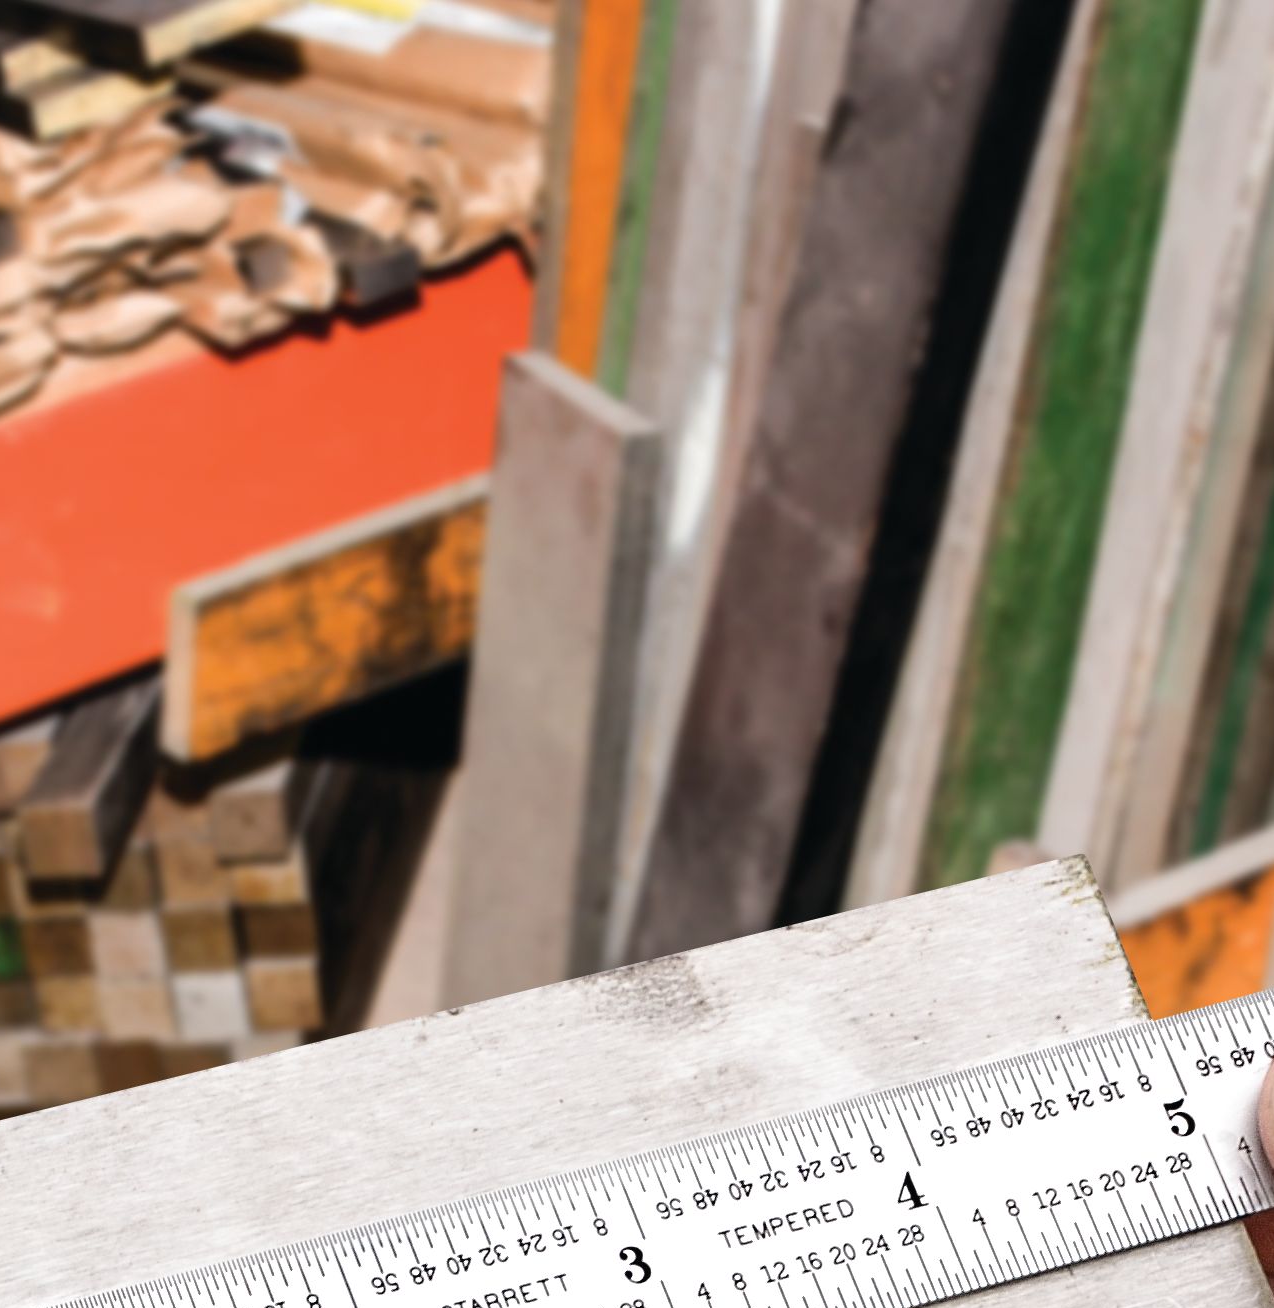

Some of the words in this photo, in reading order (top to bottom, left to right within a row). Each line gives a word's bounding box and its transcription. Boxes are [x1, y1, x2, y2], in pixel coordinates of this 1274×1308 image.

[1196, 1056, 1222, 1076] 56
[1230, 1047, 1254, 1067] 48
[1099, 1082, 1125, 1102] 16
[1138, 1075, 1152, 1092] 8
[1030, 1099, 1059, 1120] 32
[1067, 1089, 1094, 1110] 24
[966, 1117, 991, 1137] 48
[1001, 1109, 1024, 1128] 40
[931, 1126, 957, 1146] 56
[831, 1152, 857, 1173] 16
[870, 1146, 884, 1162] 8
[760, 1171, 788, 1191] 32
[797, 1160, 825, 1182] 24
[620, 1247, 651, 1284] 3
[898, 1172, 928, 1210] 4
[1164, 1098, 1195, 1136] 5
[693, 1189, 718, 1209] 48
[729, 1180, 752, 1200] 40
[657, 1199, 683, 1219] 56
[698, 1283, 711, 1300] 4
[732, 1273, 746, 1290] 8
[760, 1262, 789, 1283] 12
[796, 1252, 822, 1273] 16
[830, 1243, 855, 1264] 20
[862, 1234, 890, 1256] 24
[898, 1225, 924, 1246] 28
[973, 1208, 986, 1225] 4
[1006, 1199, 1020, 1216] 8
[1032, 1188, 1061, 1209] 12
[1067, 1179, 1093, 1200] 16
[1100, 1171, 1125, 1191] 20
[1131, 1162, 1158, 1183] 24
[1166, 1153, 1192, 1173] 28
[1238, 1137, 1251, 1154] 4
[594, 1218, 608, 1236] 8
[718, 1200, 853, 1247] TEMPERED
[517, 1234, 546, 1255] 24
[553, 1226, 579, 1247] 16
[447, 1255, 471, 1275] 40
[479, 1245, 508, 1266] 32
[371, 1273, 399, 1294] 56
[410, 1264, 436, 1284] 48
